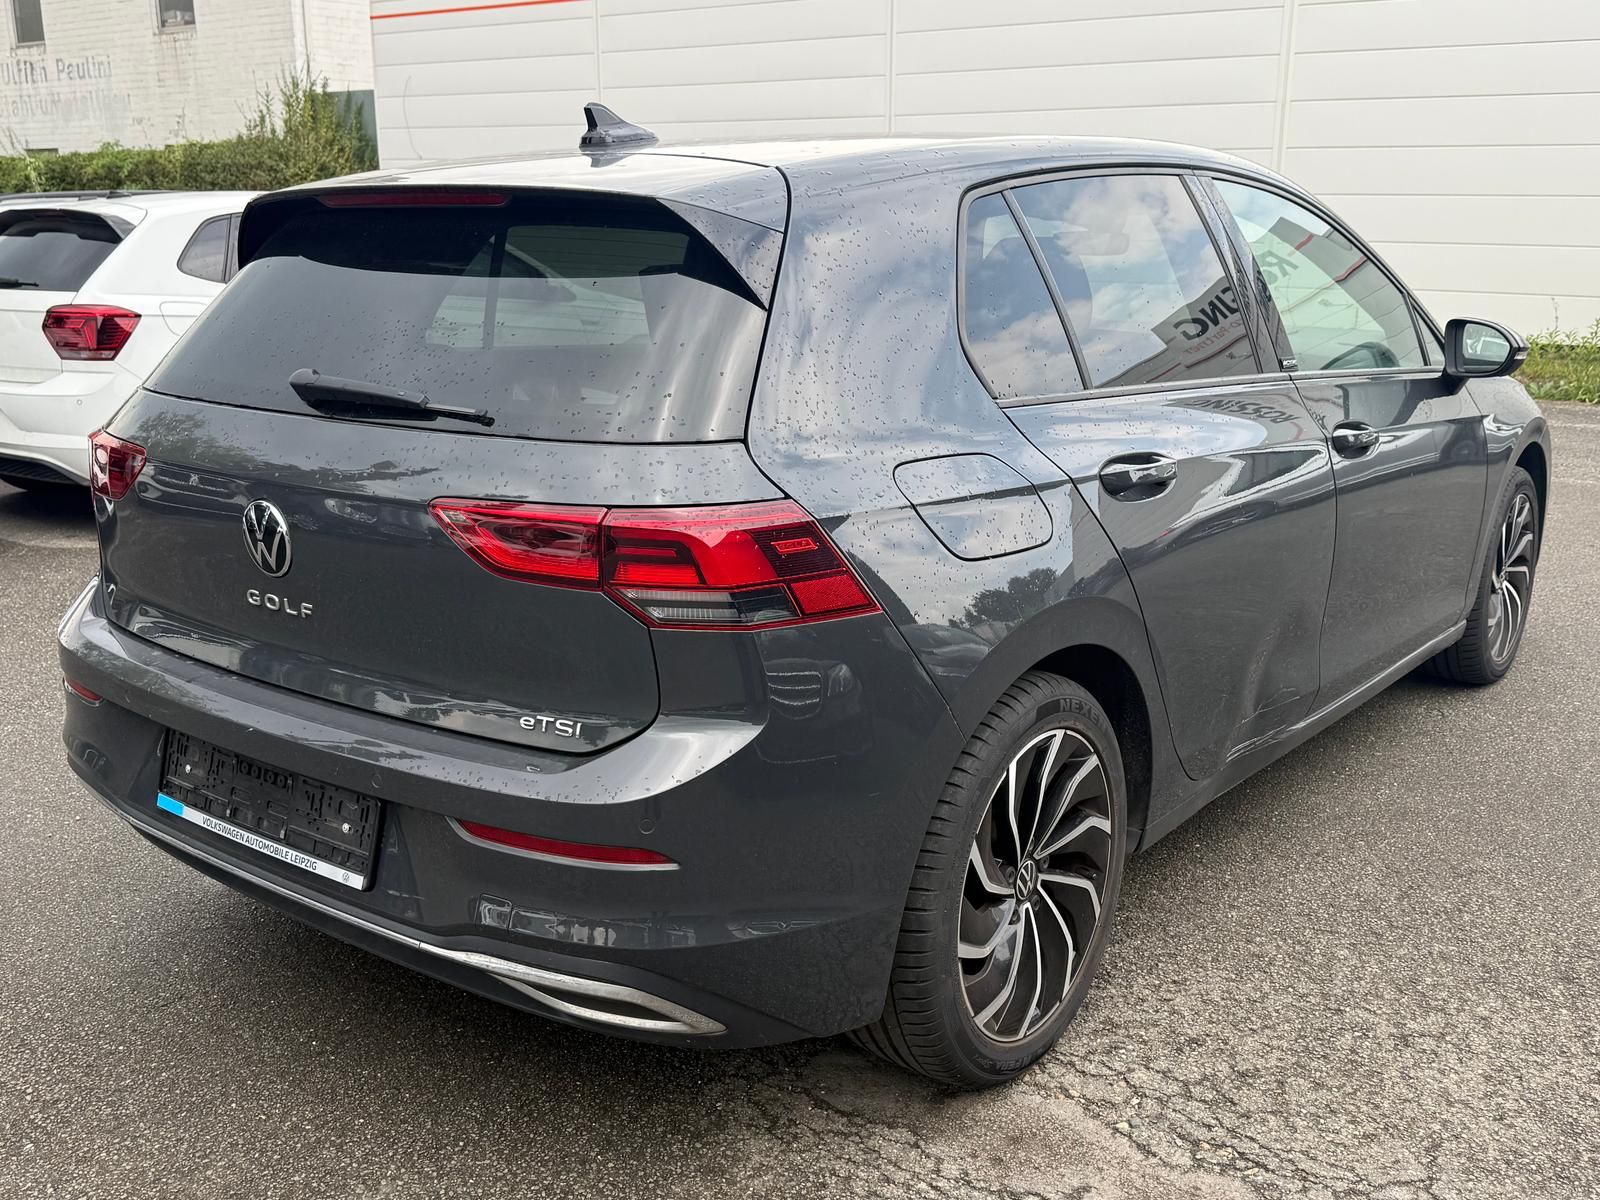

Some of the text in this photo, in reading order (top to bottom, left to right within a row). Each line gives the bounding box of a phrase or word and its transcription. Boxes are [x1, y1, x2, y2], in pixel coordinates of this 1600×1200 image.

[246, 589, 313, 618] GOLF
[520, 715, 582, 739] eTSI
[202, 816, 318, 871] VOLKSWAGEN AUTOMOBILE LEIPZIG
